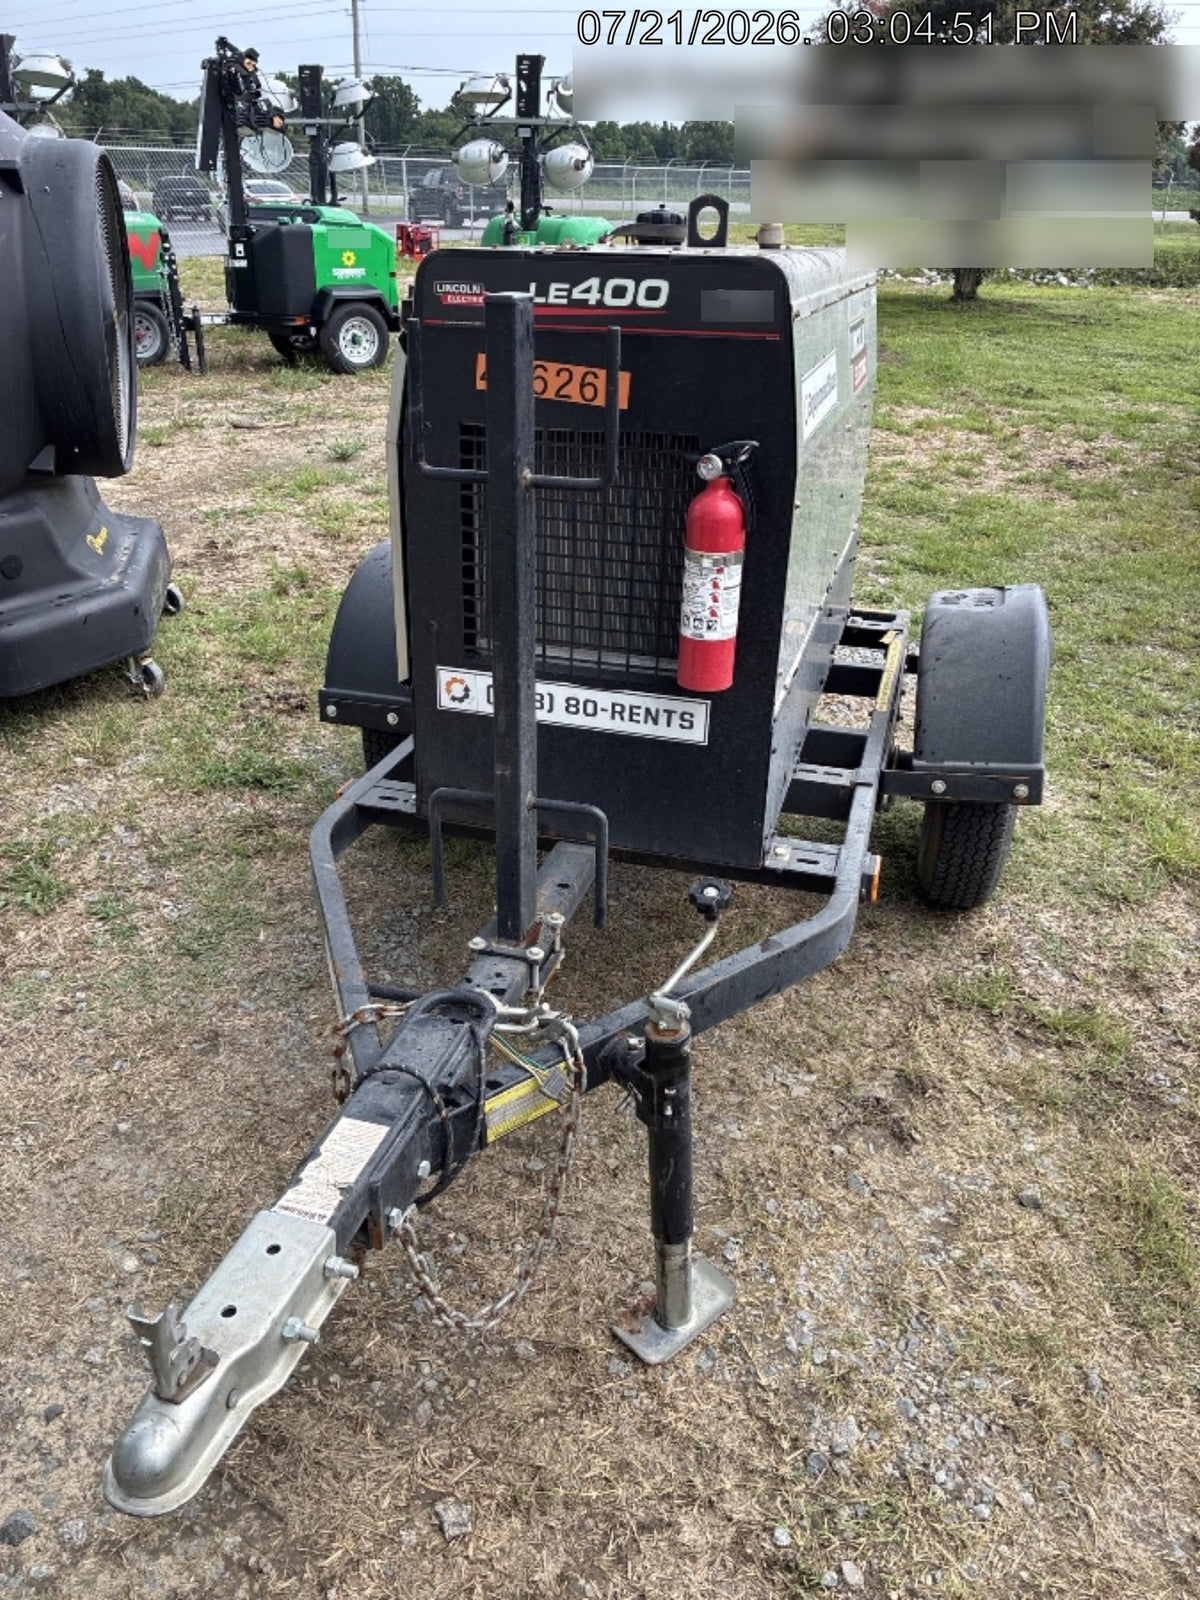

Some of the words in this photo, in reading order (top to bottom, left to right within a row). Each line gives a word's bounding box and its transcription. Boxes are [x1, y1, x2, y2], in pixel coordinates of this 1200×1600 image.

[436, 283, 481, 294] LINCOLN
[528, 276, 670, 309] LE400
[479, 363, 600, 403] 626
[486, 684, 554, 714] (8)
[564, 695, 696, 731] 80-RENTS
